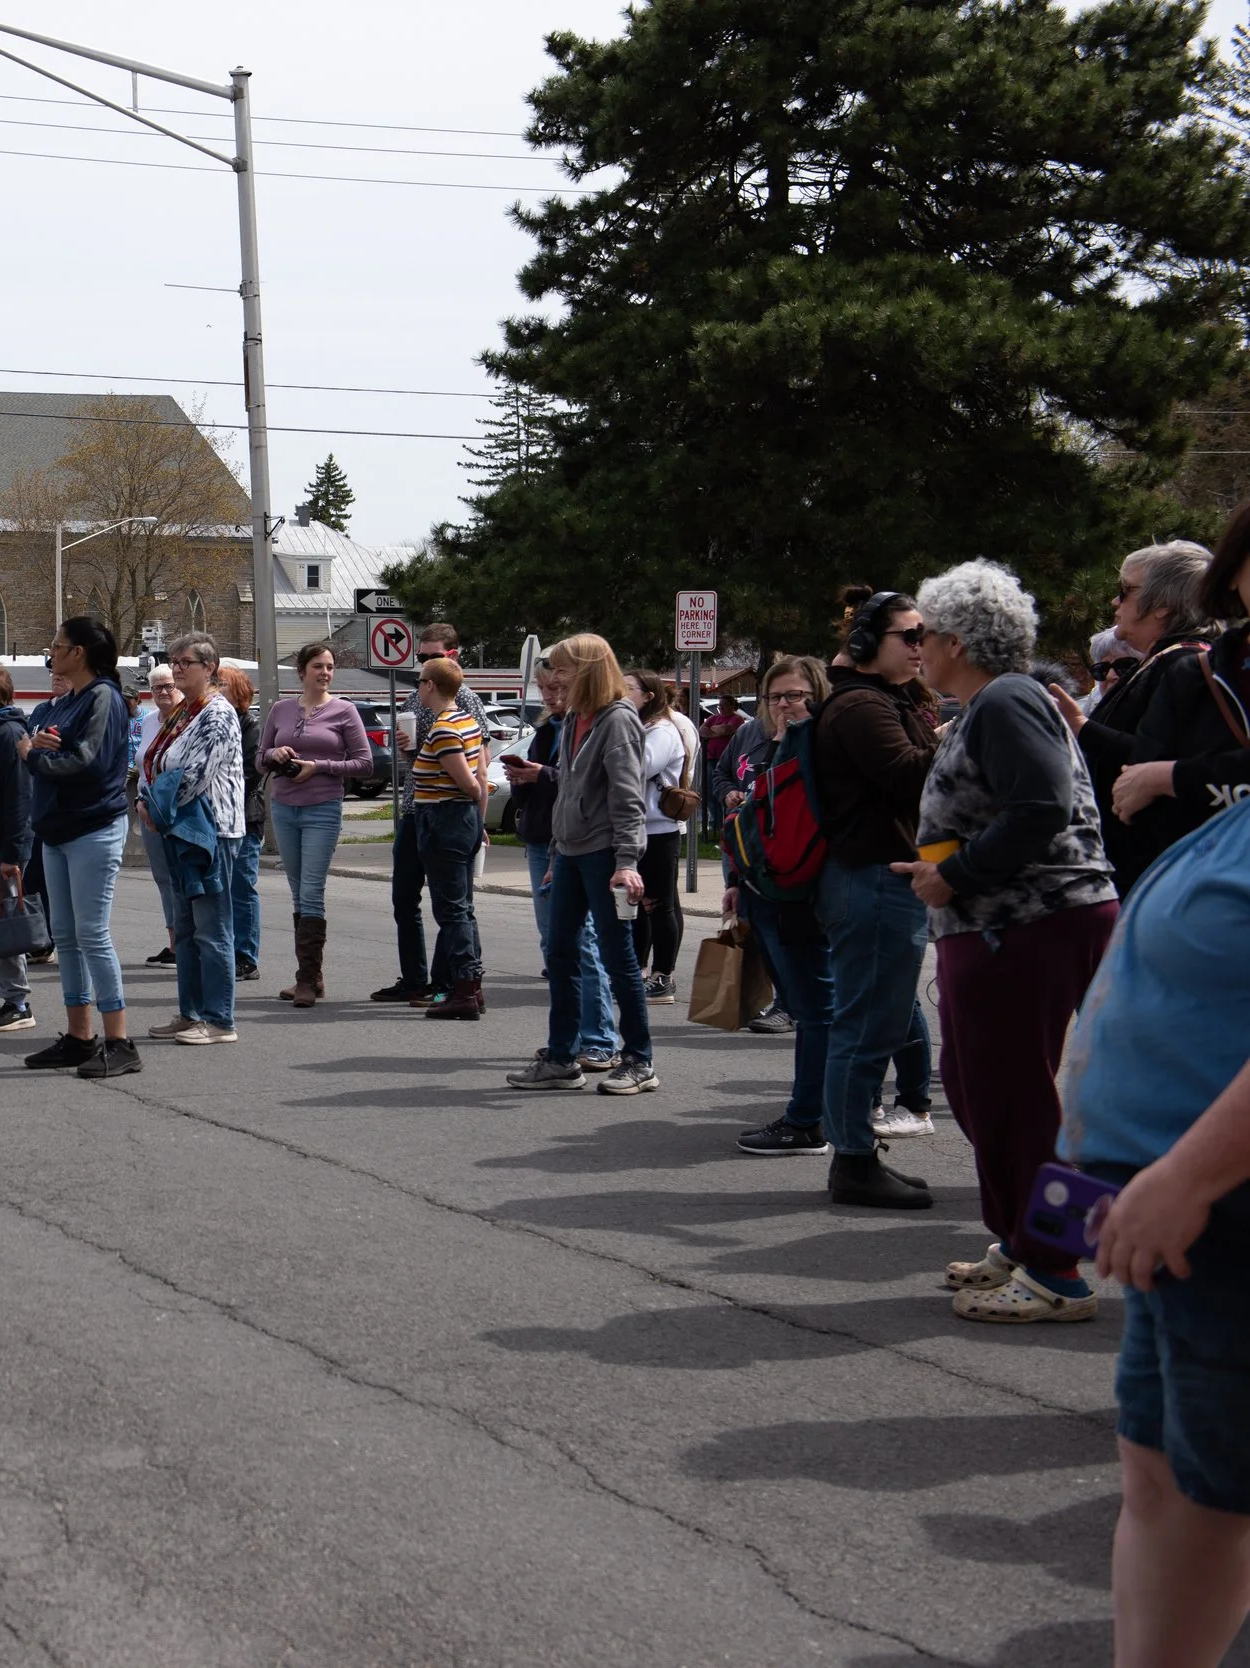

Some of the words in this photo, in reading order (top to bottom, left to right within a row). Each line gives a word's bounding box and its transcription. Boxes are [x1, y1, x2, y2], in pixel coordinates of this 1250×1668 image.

[376, 597, 395, 606] ONE
[689, 597, 704, 608] NO
[680, 610, 714, 620] PARKING
